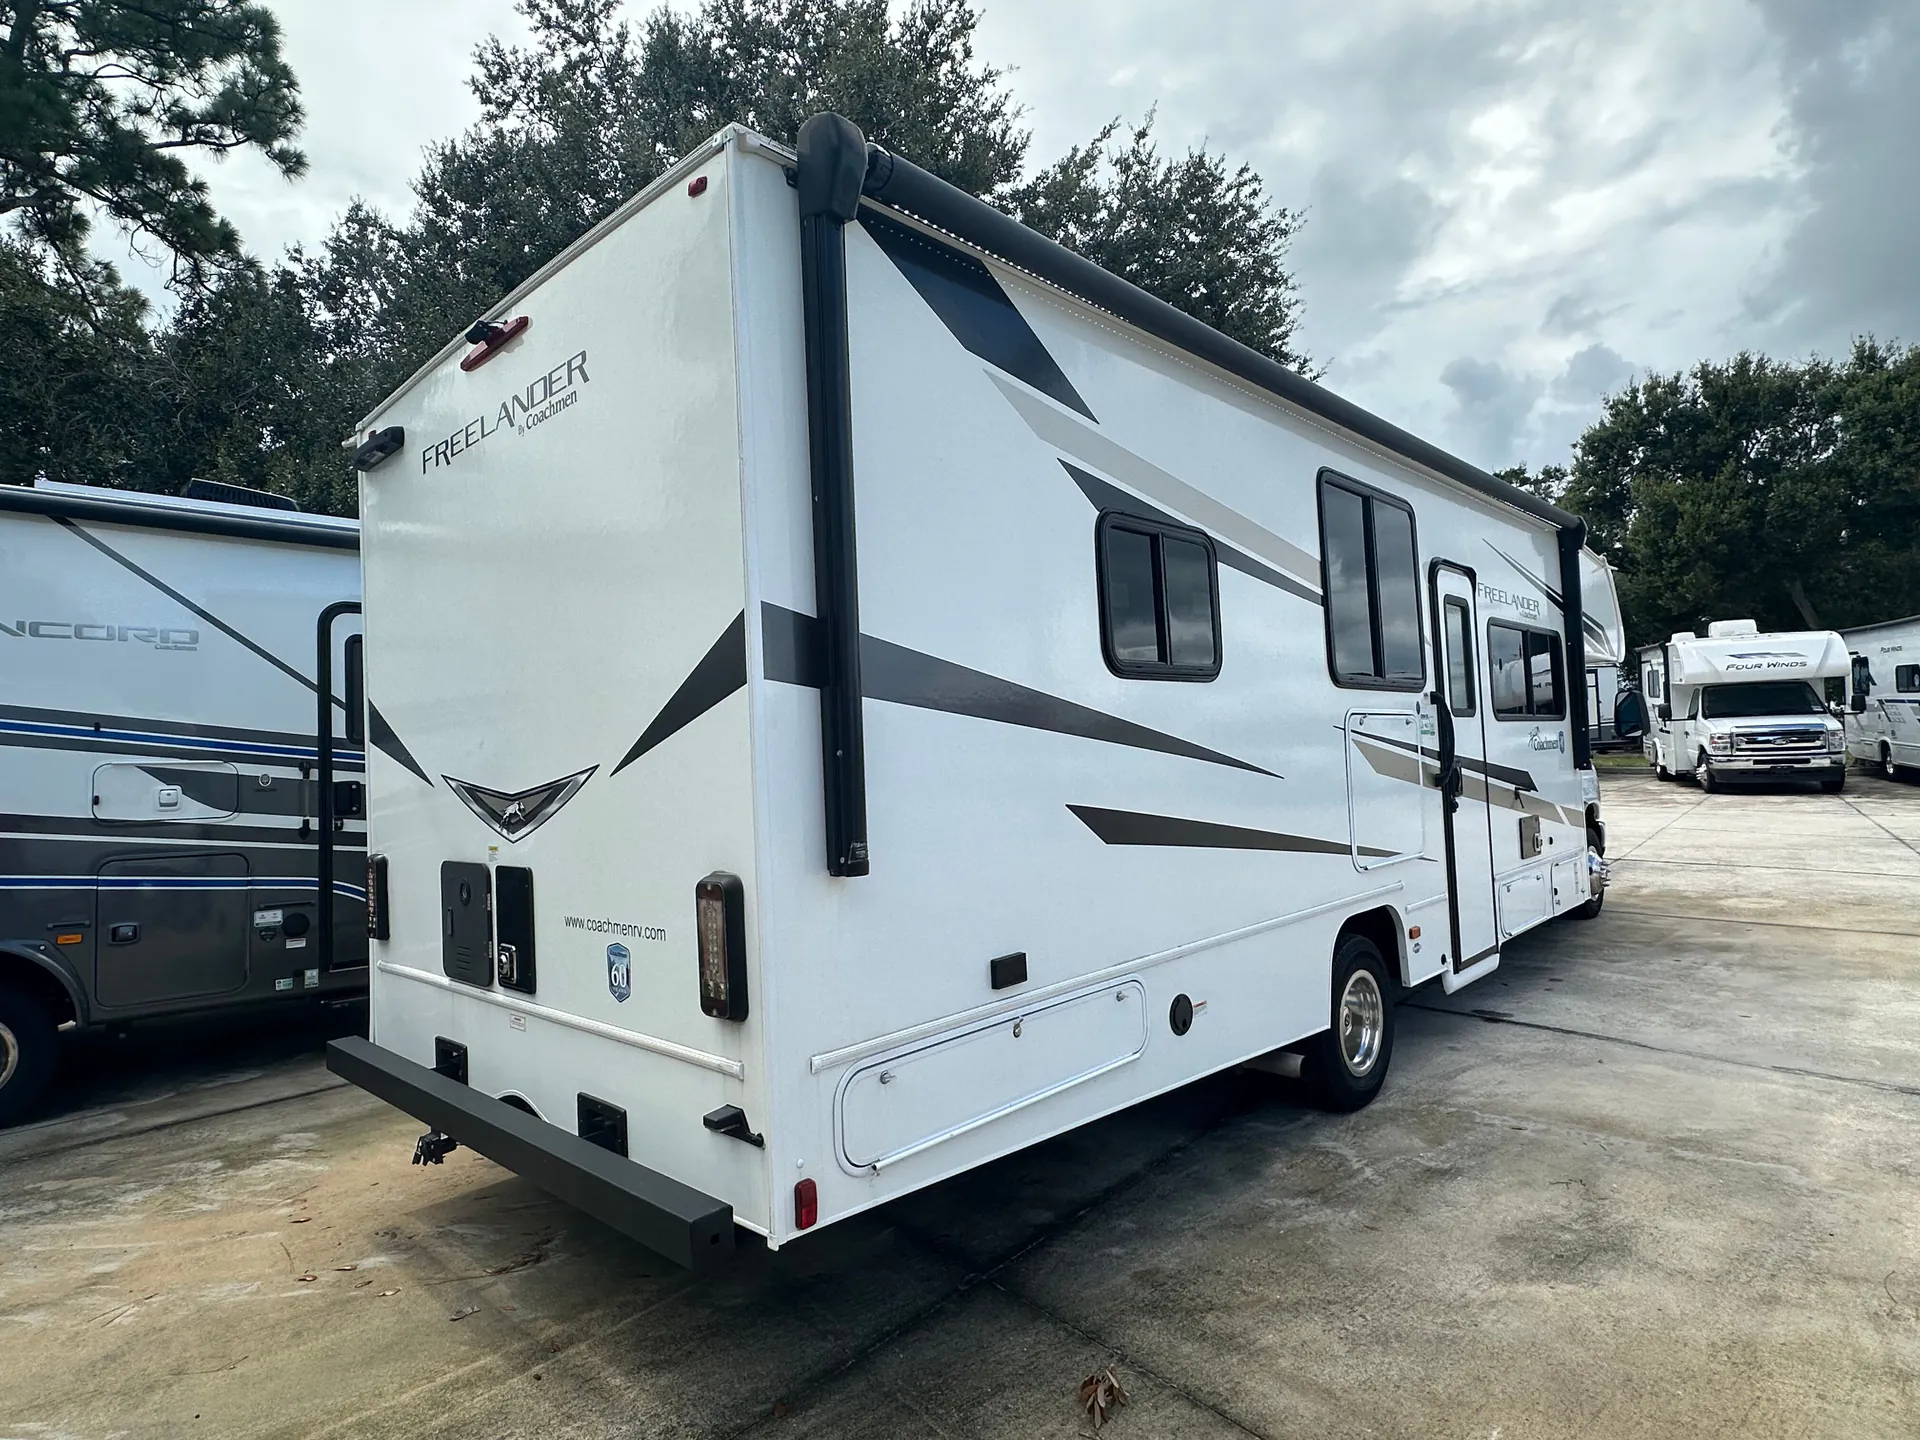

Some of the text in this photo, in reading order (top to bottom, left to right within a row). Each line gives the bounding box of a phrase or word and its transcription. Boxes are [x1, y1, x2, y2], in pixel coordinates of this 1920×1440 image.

[422, 349, 590, 475] FREELANDER
[525, 390, 578, 430] Coachmen
[1477, 582, 1540, 616] FREELANDER
[1725, 663, 1763, 671] FOUR
[564, 916, 666, 941] www.coachmenrv.com
[611, 963, 627, 987] 60
